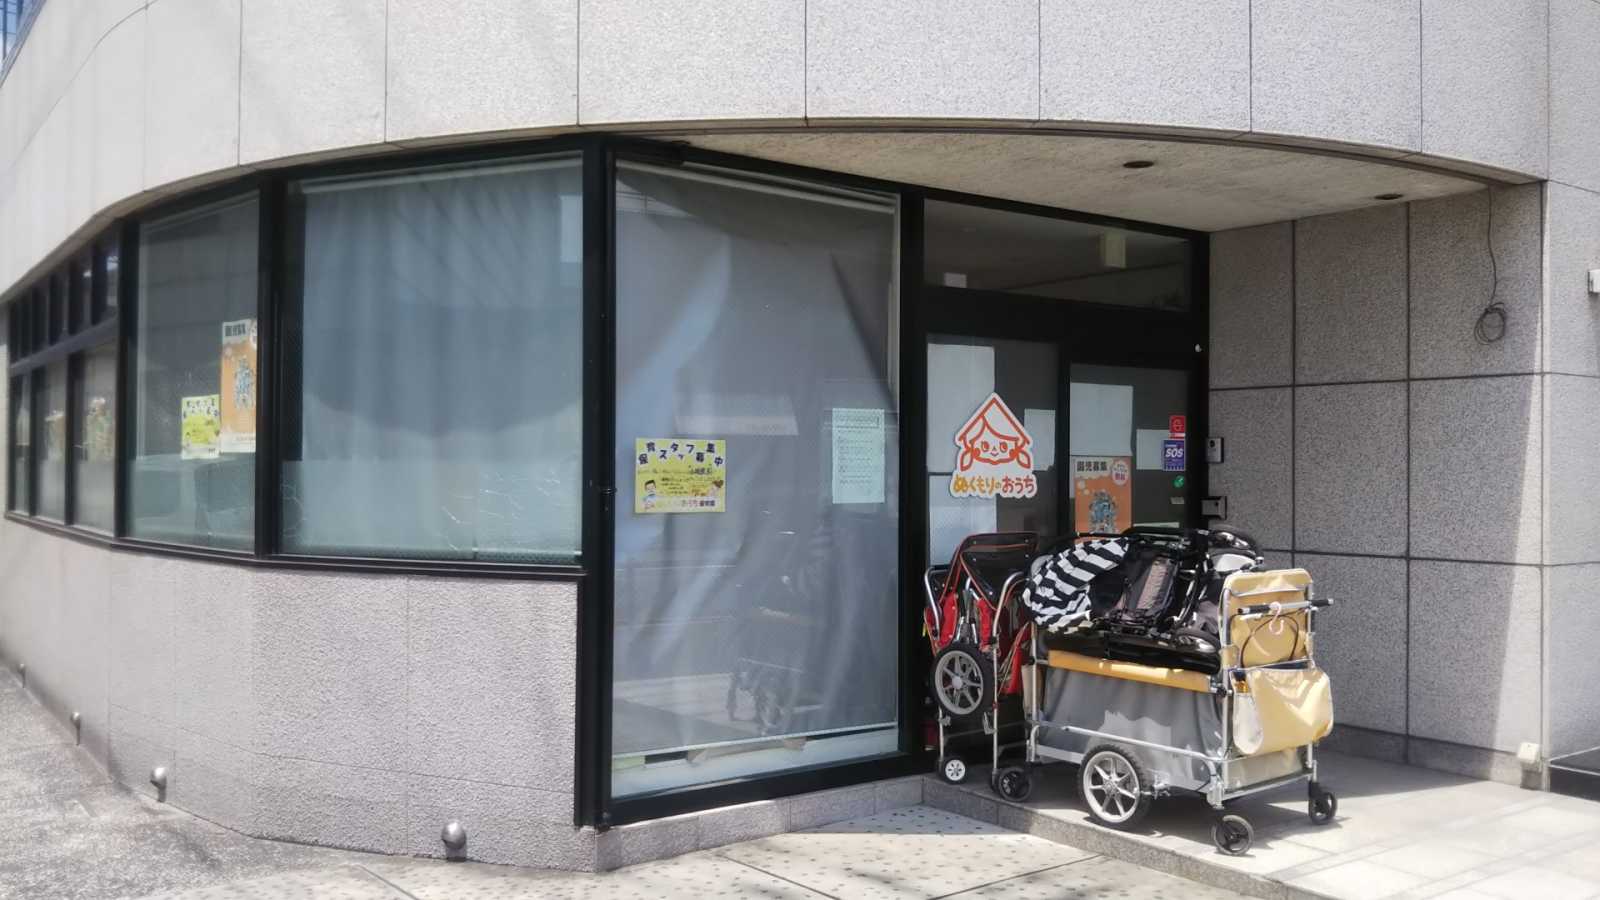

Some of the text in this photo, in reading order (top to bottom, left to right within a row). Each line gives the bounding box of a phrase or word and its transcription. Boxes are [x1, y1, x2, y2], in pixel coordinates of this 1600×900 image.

[638, 441, 724, 467] 保育スタッフ募集中
[1165, 447, 1184, 458] SOS
[953, 474, 1035, 495] ぬくもりのおうち
